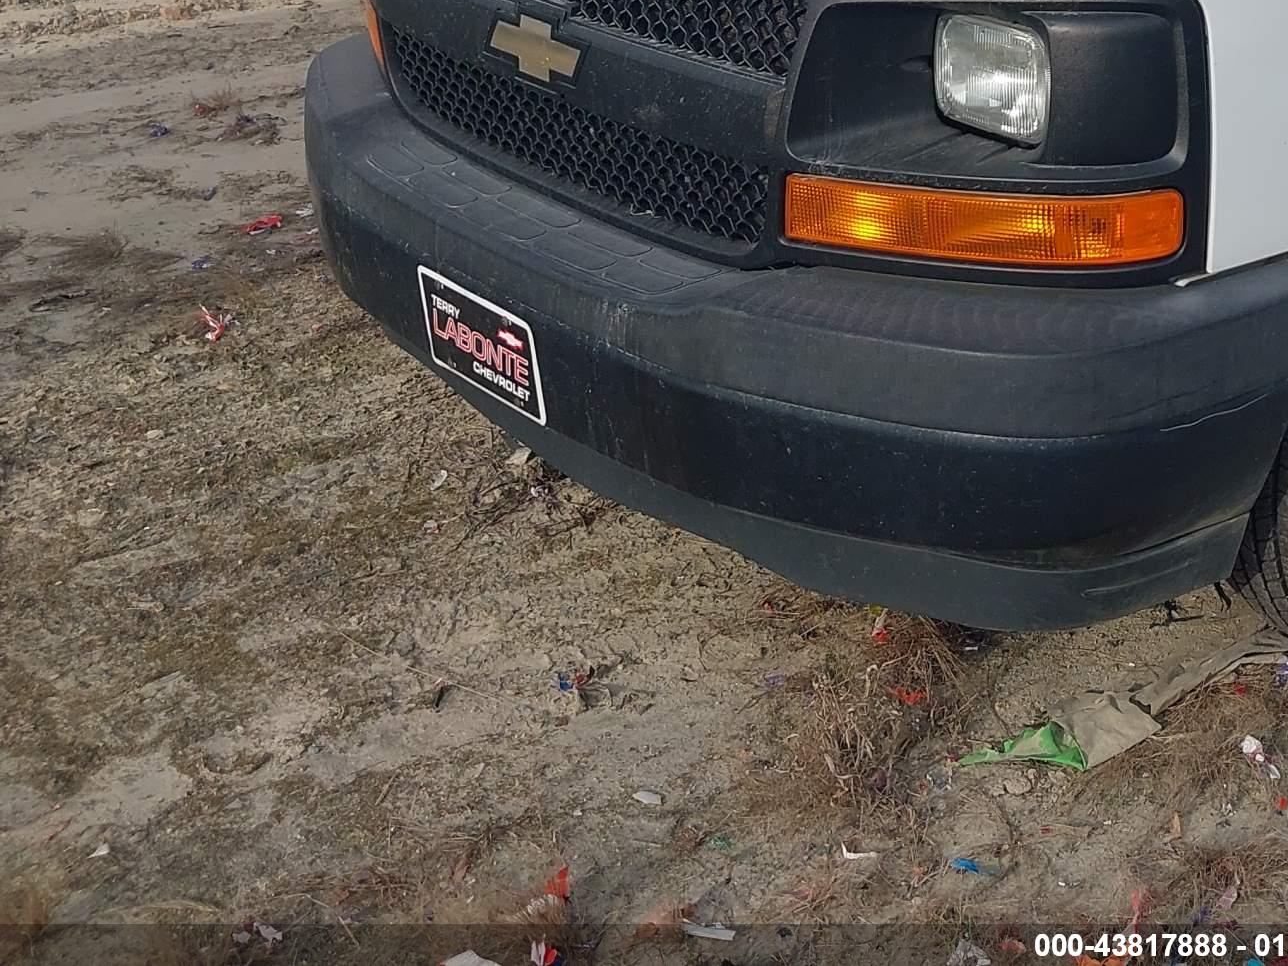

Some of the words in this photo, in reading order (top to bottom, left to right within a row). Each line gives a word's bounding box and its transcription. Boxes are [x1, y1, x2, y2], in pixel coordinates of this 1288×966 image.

[430, 292, 461, 320] TERRY
[432, 306, 529, 387] LABONTE
[472, 360, 531, 403] CHEVROLET
